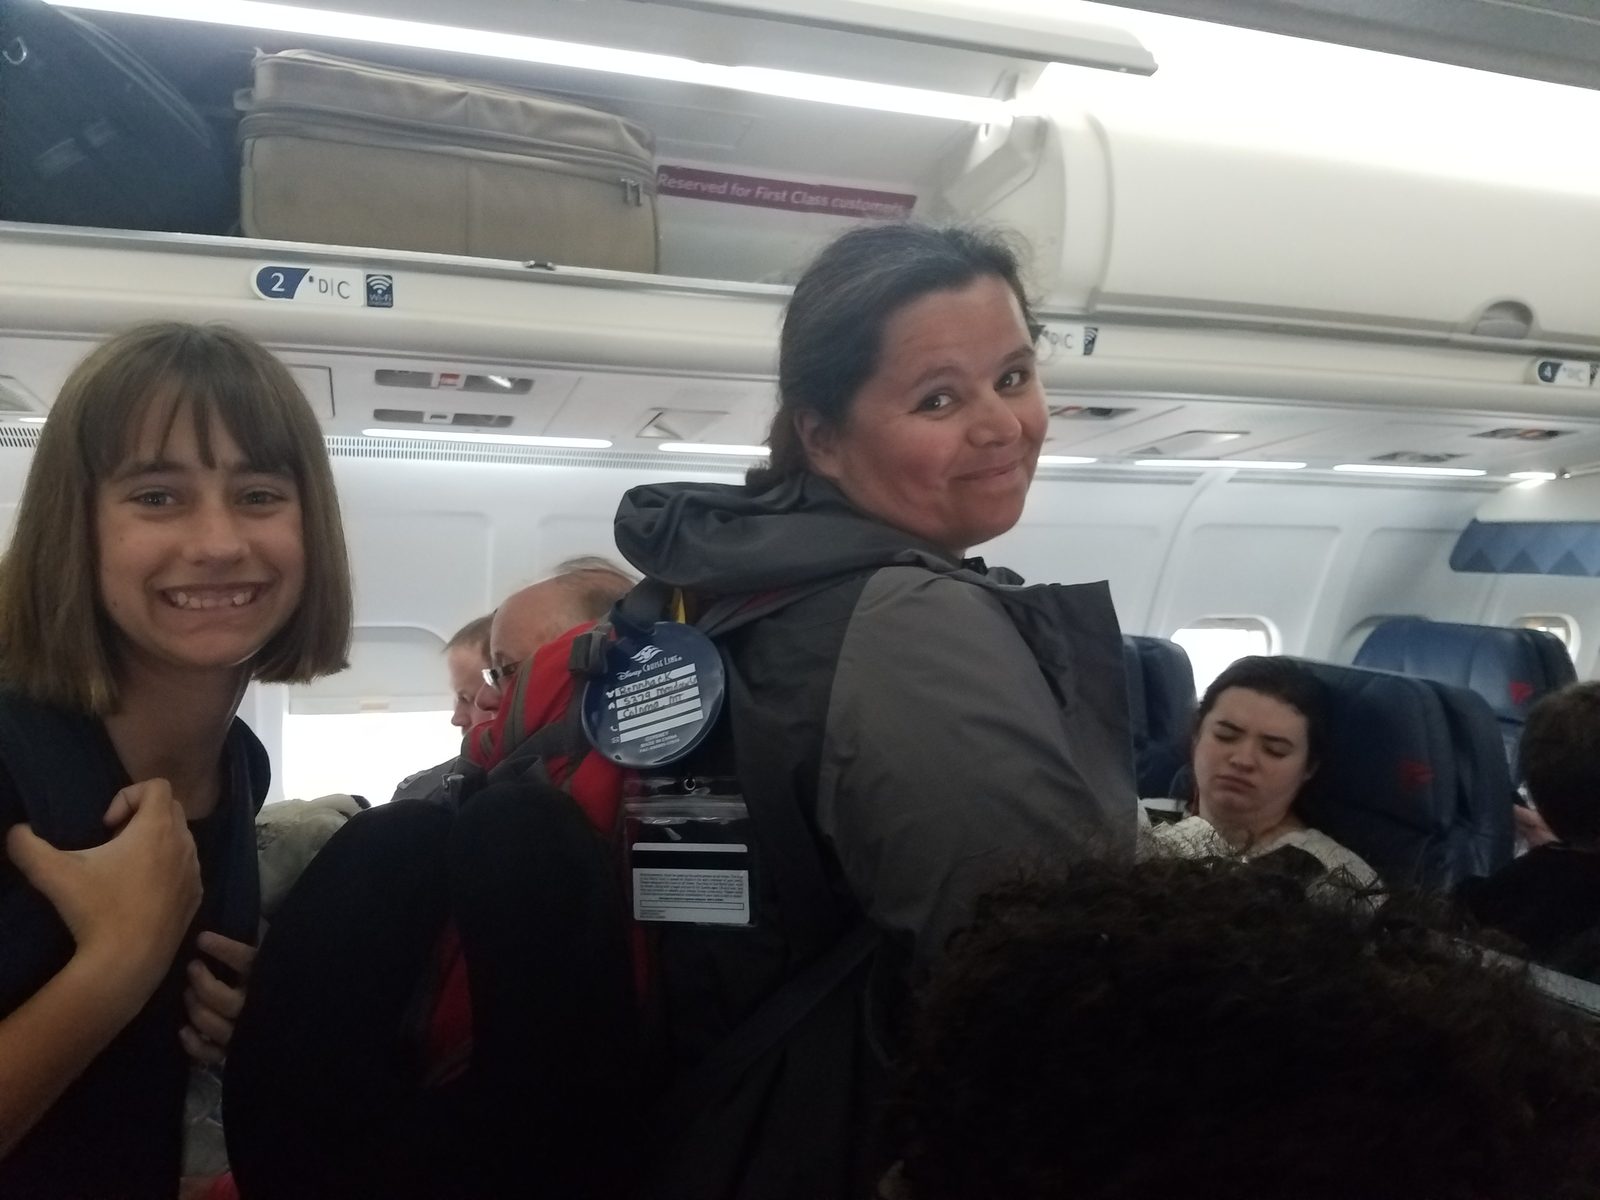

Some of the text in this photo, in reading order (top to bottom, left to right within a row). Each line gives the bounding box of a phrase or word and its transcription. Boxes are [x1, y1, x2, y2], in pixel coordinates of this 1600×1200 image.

[658, 173, 729, 195] Reserved
[730, 182, 752, 198] for
[754, 186, 788, 203] First
[790, 190, 829, 208] Class
[270, 272, 285, 292] 2
[616, 669, 642, 681] Disney
